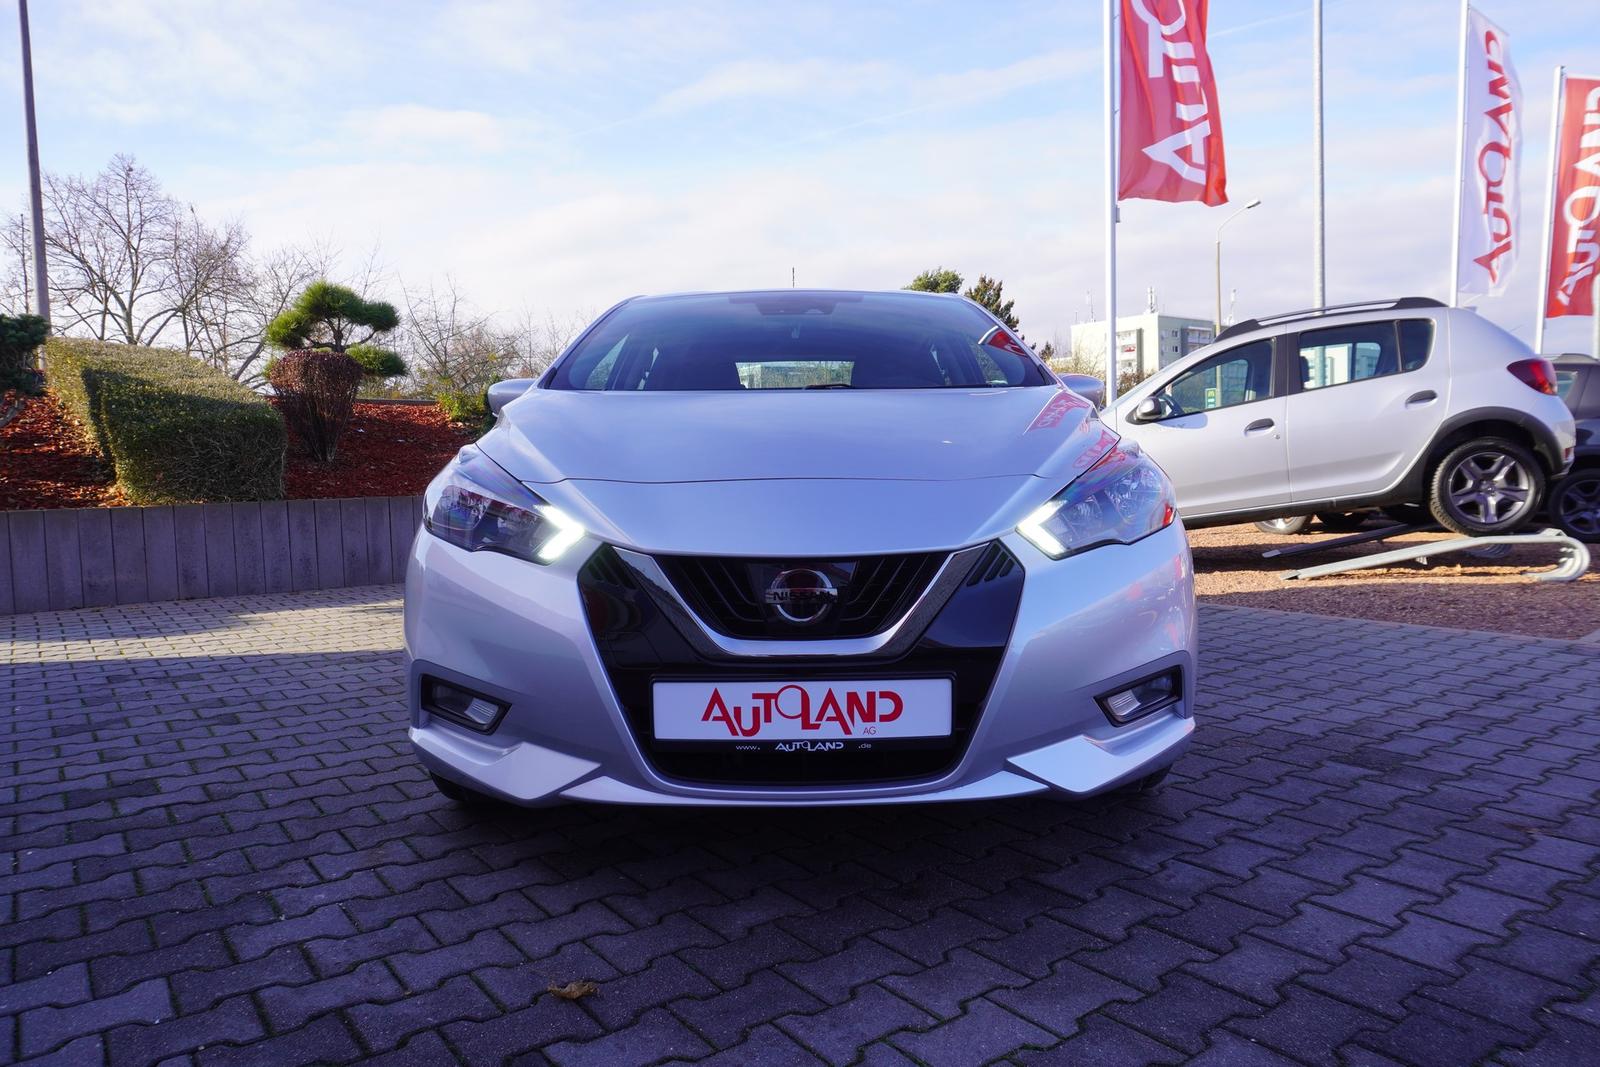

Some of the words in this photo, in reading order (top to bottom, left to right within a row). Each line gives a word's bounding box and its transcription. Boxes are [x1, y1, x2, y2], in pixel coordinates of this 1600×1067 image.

[701, 685, 904, 737] AUTOLAND
[862, 726, 877, 735] AG
[775, 740, 844, 752] AUTOLAND
